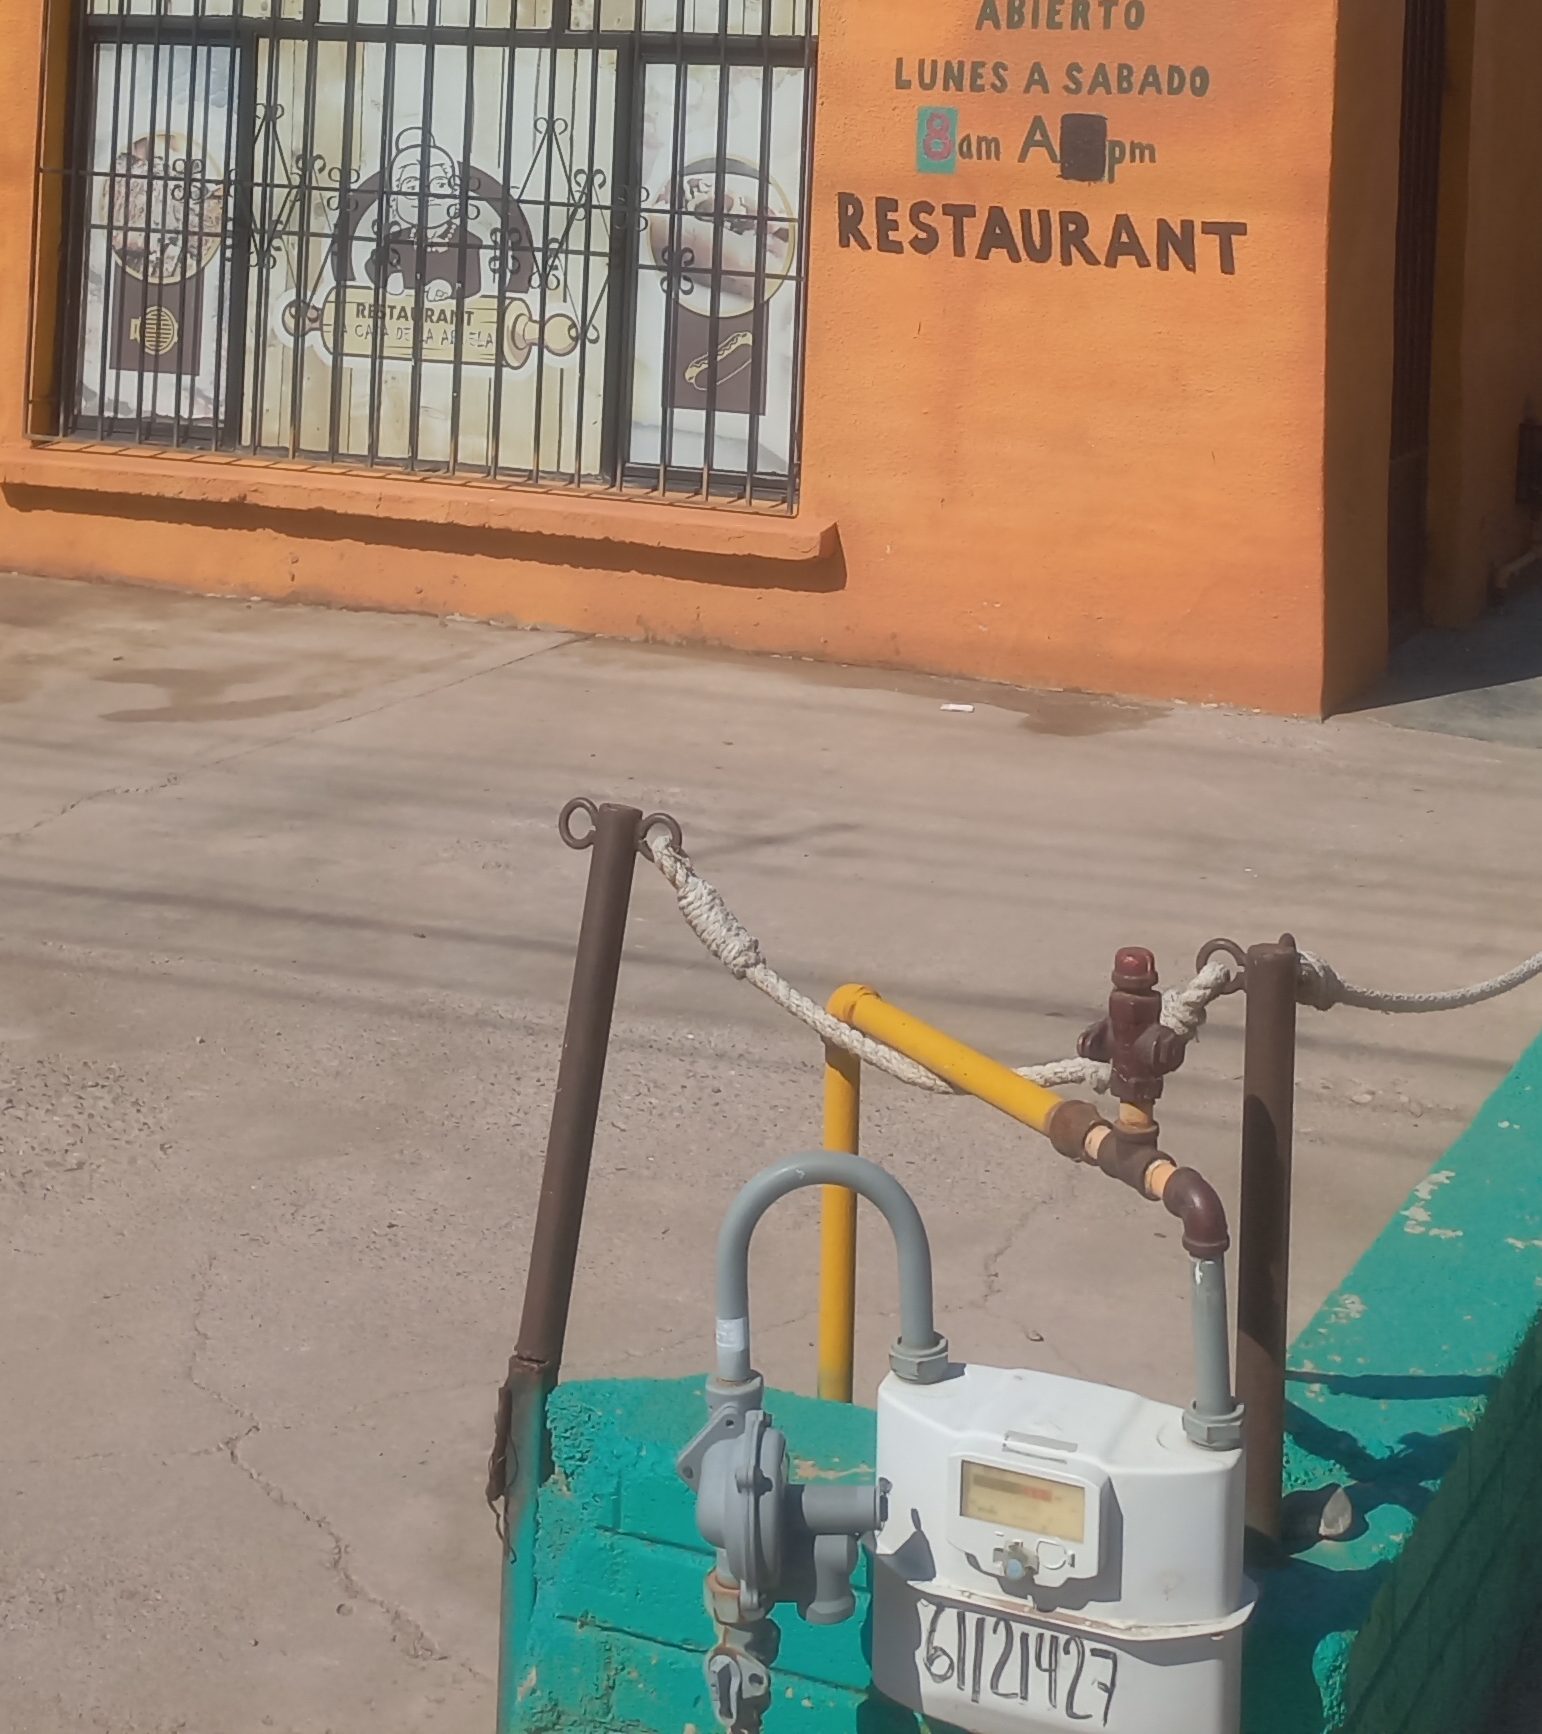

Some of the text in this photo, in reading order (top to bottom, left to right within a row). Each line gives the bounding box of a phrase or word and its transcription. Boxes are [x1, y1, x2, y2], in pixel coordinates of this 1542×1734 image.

[895, 57, 1210, 96] LUNES A SABADO
[1017, 115, 1059, 164] A
[837, 191, 1248, 275] RESTAURANT
[356, 302, 474, 326] RESTARAT
[441, 328, 494, 348] ABELA
